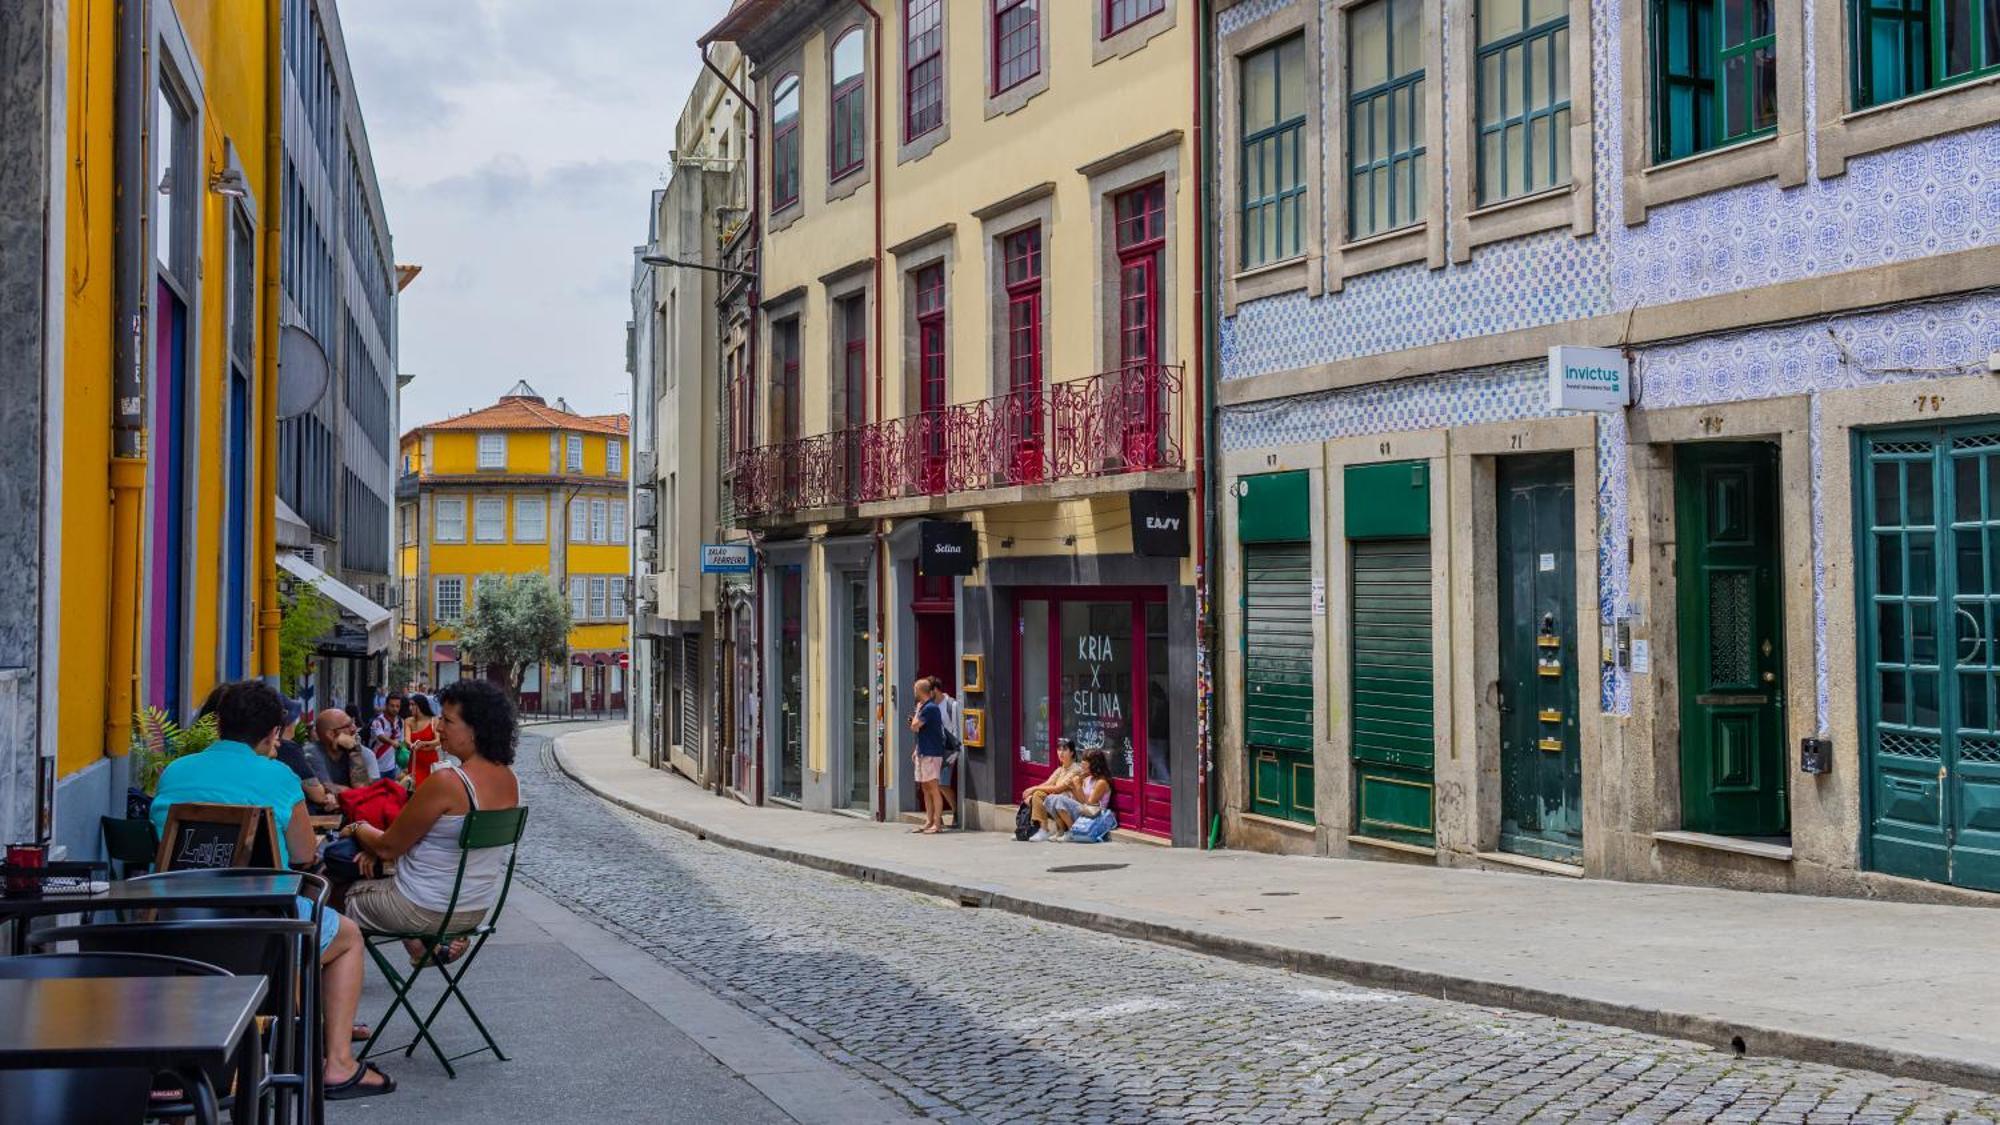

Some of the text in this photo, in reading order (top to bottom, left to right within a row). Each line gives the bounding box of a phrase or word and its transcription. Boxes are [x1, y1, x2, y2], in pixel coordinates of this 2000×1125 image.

[1146, 516, 1180, 531] EASY
[935, 543, 961, 553] Selina
[1079, 635, 1113, 662] KRIA
[1090, 663, 1101, 688] X
[1074, 690, 1121, 719] SELINA
